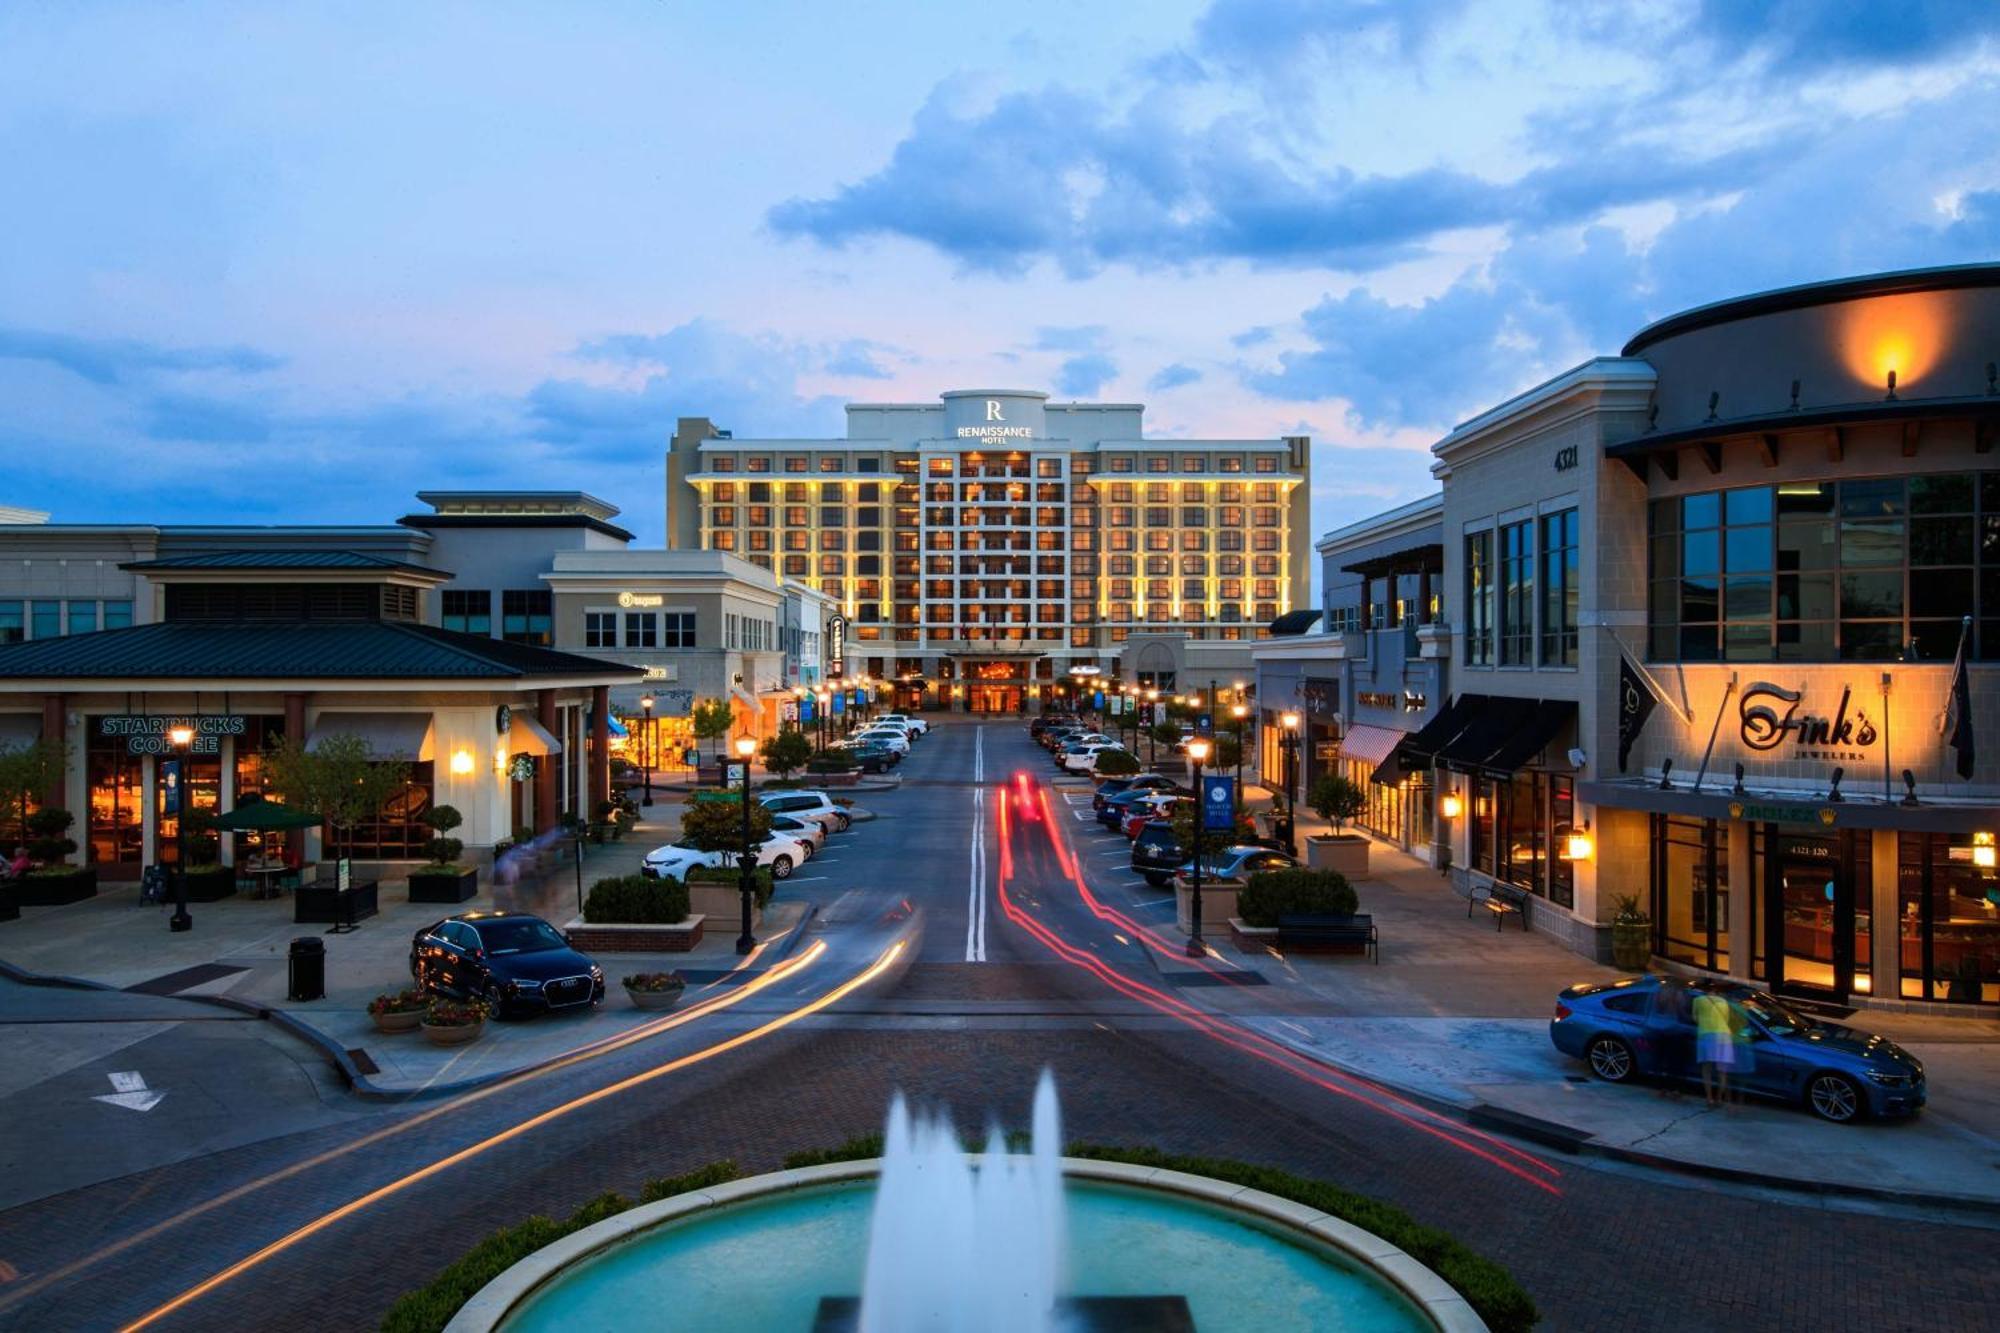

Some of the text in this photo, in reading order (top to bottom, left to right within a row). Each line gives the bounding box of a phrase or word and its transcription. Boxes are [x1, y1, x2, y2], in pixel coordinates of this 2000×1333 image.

[986, 400, 1007, 421] R
[957, 426, 1032, 438] RENAISSANCE
[981, 436, 1007, 446] HOTEL
[1553, 445, 1578, 472] 4321
[1739, 681, 1877, 751] Fink's
[128, 735, 219, 753] COFEE
[1794, 751, 1866, 761] JEWELERS
